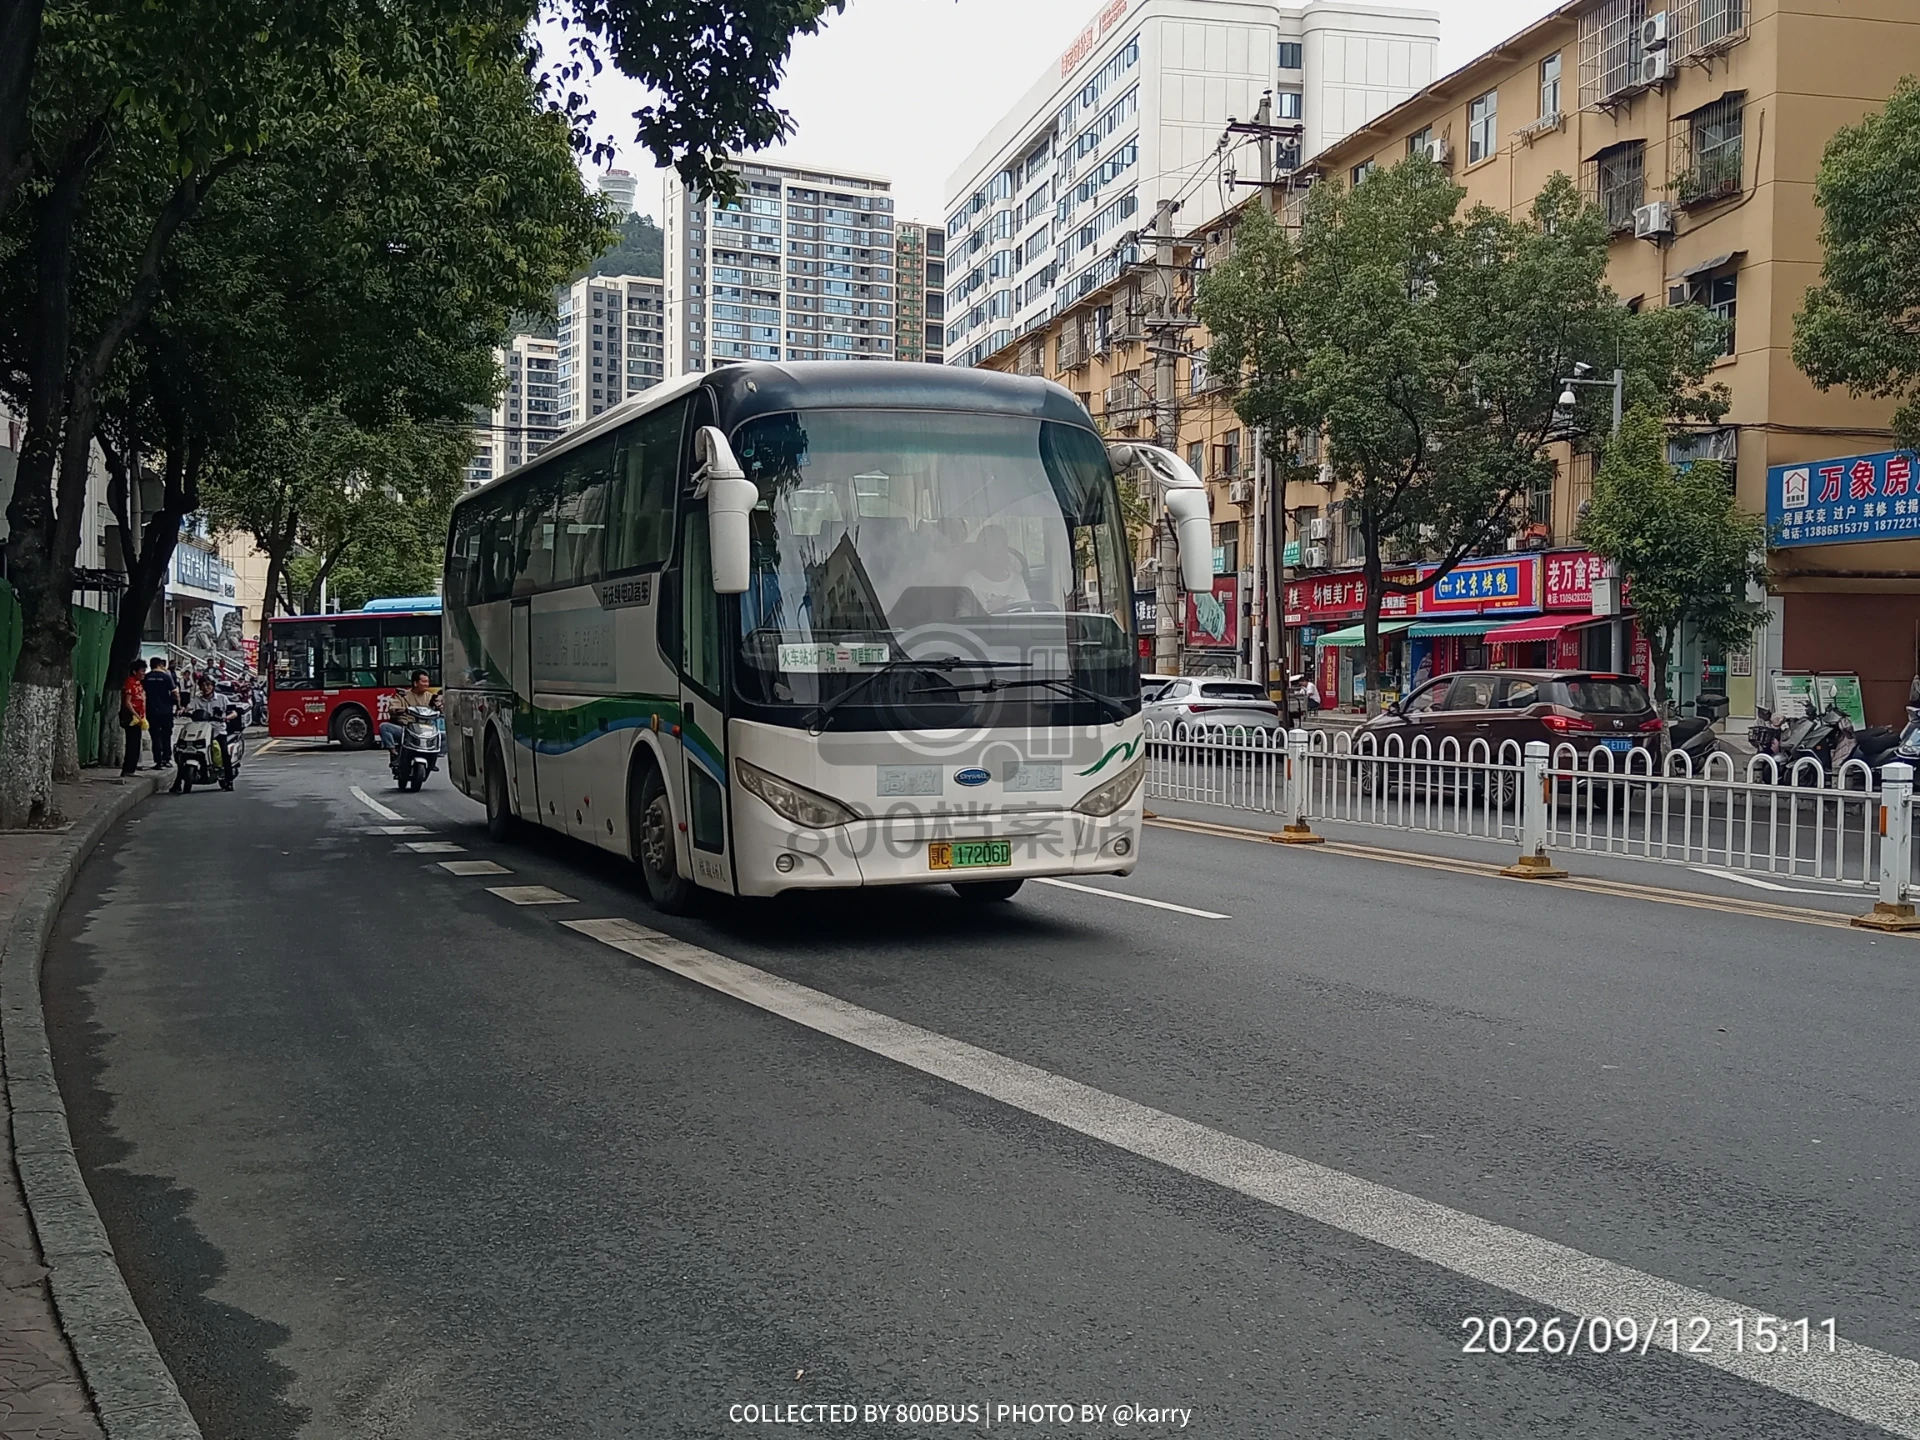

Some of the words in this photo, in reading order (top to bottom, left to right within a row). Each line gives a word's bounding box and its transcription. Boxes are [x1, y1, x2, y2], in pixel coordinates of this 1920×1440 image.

[1818, 454, 1920, 503] 万象房
[1783, 508, 1827, 526] 房屋买卖
[1833, 505, 1856, 520] 过户
[1863, 501, 1888, 518] 装修
[1895, 498, 1919, 515] 按揭
[1874, 517, 1920, 531] 1877221
[1312, 580, 1365, 609] 新恒美广告
[1455, 569, 1508, 597] 北京烤鸭
[781, 648, 836, 667] 火车站北广场
[1635, 632, 1647, 686] 正宗散养
